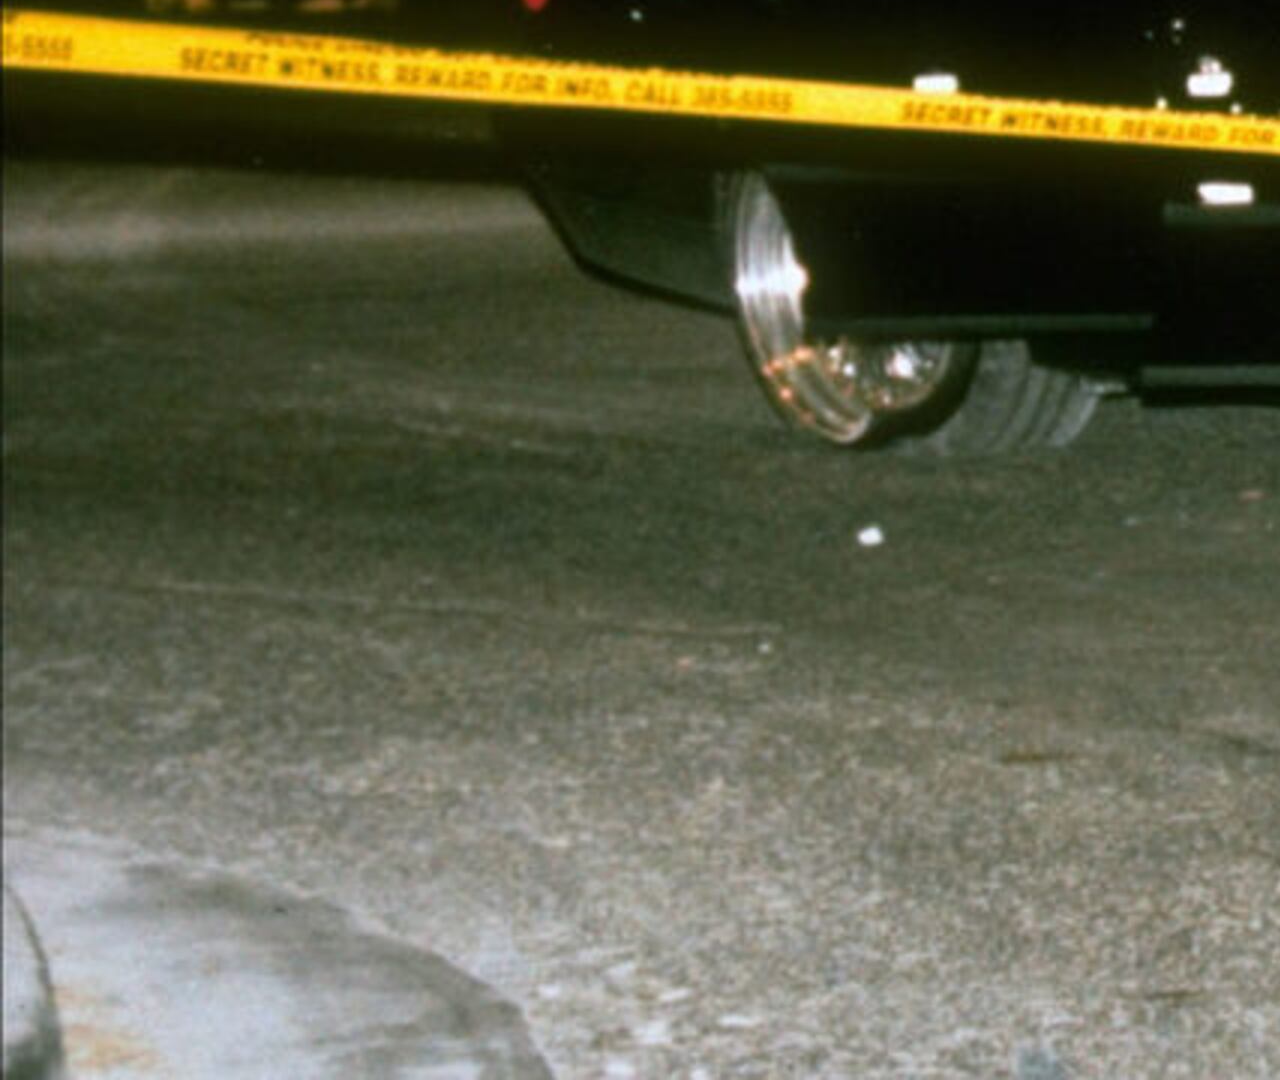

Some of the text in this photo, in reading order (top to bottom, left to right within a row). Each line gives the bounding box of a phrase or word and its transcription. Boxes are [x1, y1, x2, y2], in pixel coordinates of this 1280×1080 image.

[179, 45, 269, 74] SECRET
[394, 63, 491, 90] REWARD
[501, 73, 548, 95] FOR
[624, 81, 679, 106] CALL
[900, 100, 991, 126] SECRET
[1119, 118, 1220, 142] REWARD
[1228, 125, 1276, 145] FOR
